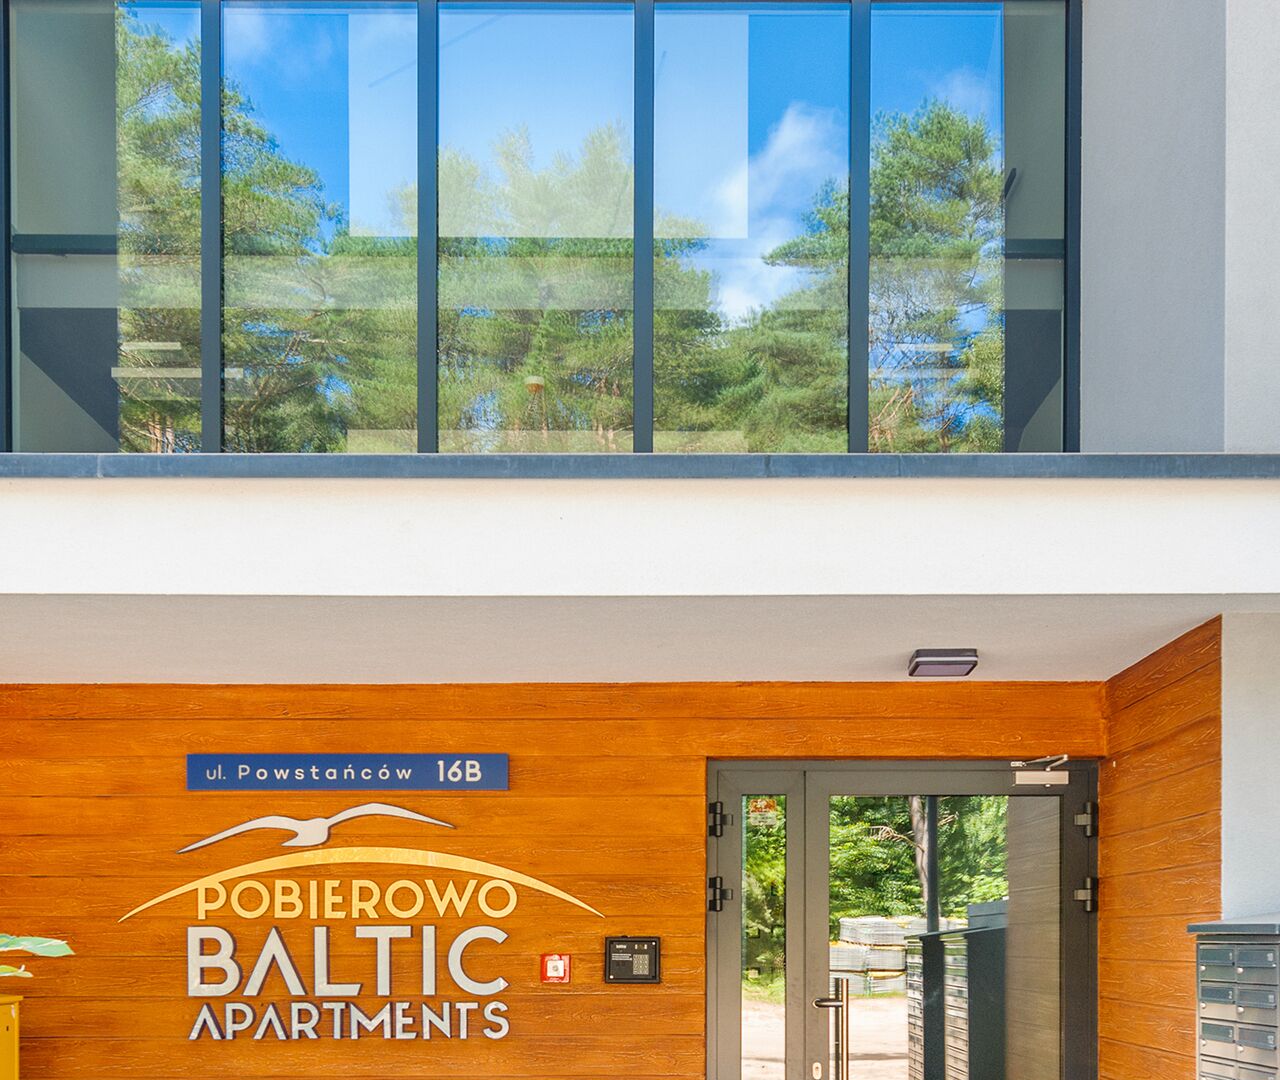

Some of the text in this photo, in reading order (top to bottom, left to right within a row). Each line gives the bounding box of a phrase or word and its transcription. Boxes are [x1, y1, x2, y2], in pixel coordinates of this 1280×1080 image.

[206, 760, 482, 782] ul. Powstańców 16B
[196, 879, 518, 920] POBIEROWO
[187, 925, 510, 997] BALTIC
[188, 1001, 511, 1040] APARTMENTS
